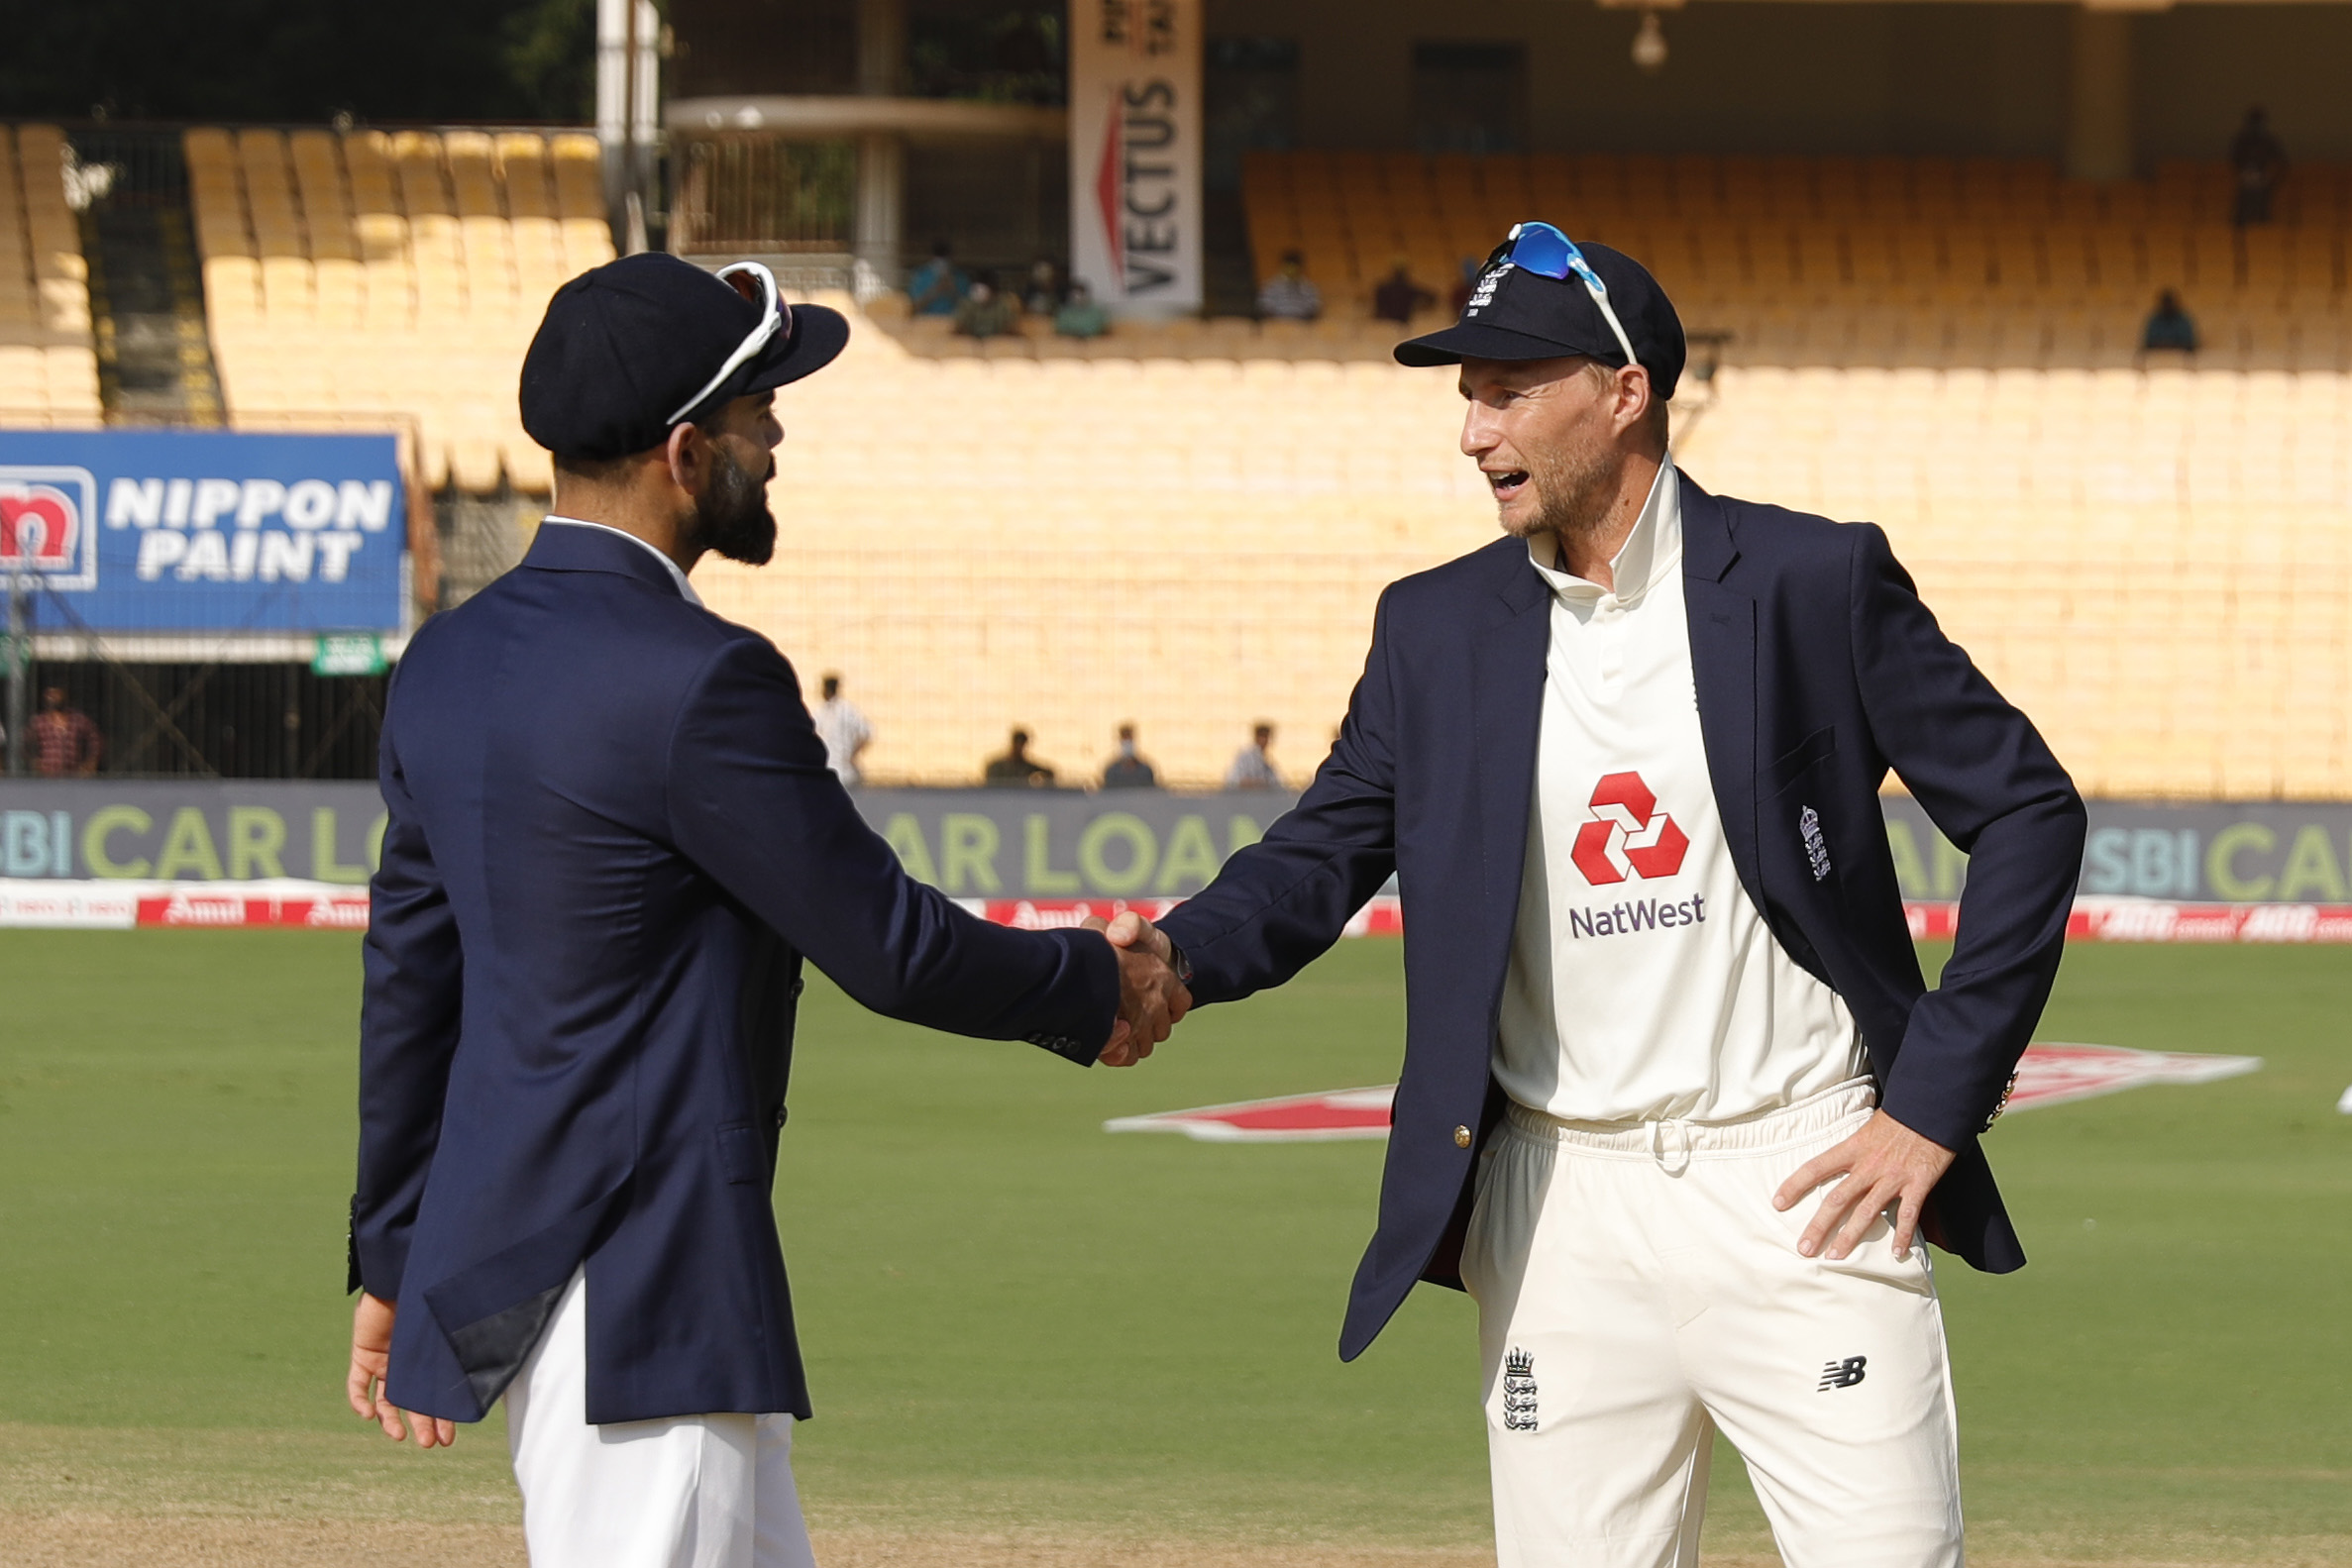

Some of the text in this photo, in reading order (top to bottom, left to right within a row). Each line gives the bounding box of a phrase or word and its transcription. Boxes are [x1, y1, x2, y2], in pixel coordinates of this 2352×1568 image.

[1123, 79, 1176, 295] VECTUS
[104, 477, 393, 533] NIPPON
[135, 528, 364, 583] PAINT
[0, 810, 72, 878] BI
[81, 804, 287, 880] CAR
[2086, 821, 2352, 901] SBI CA
[1568, 891, 1706, 939] NatWest
